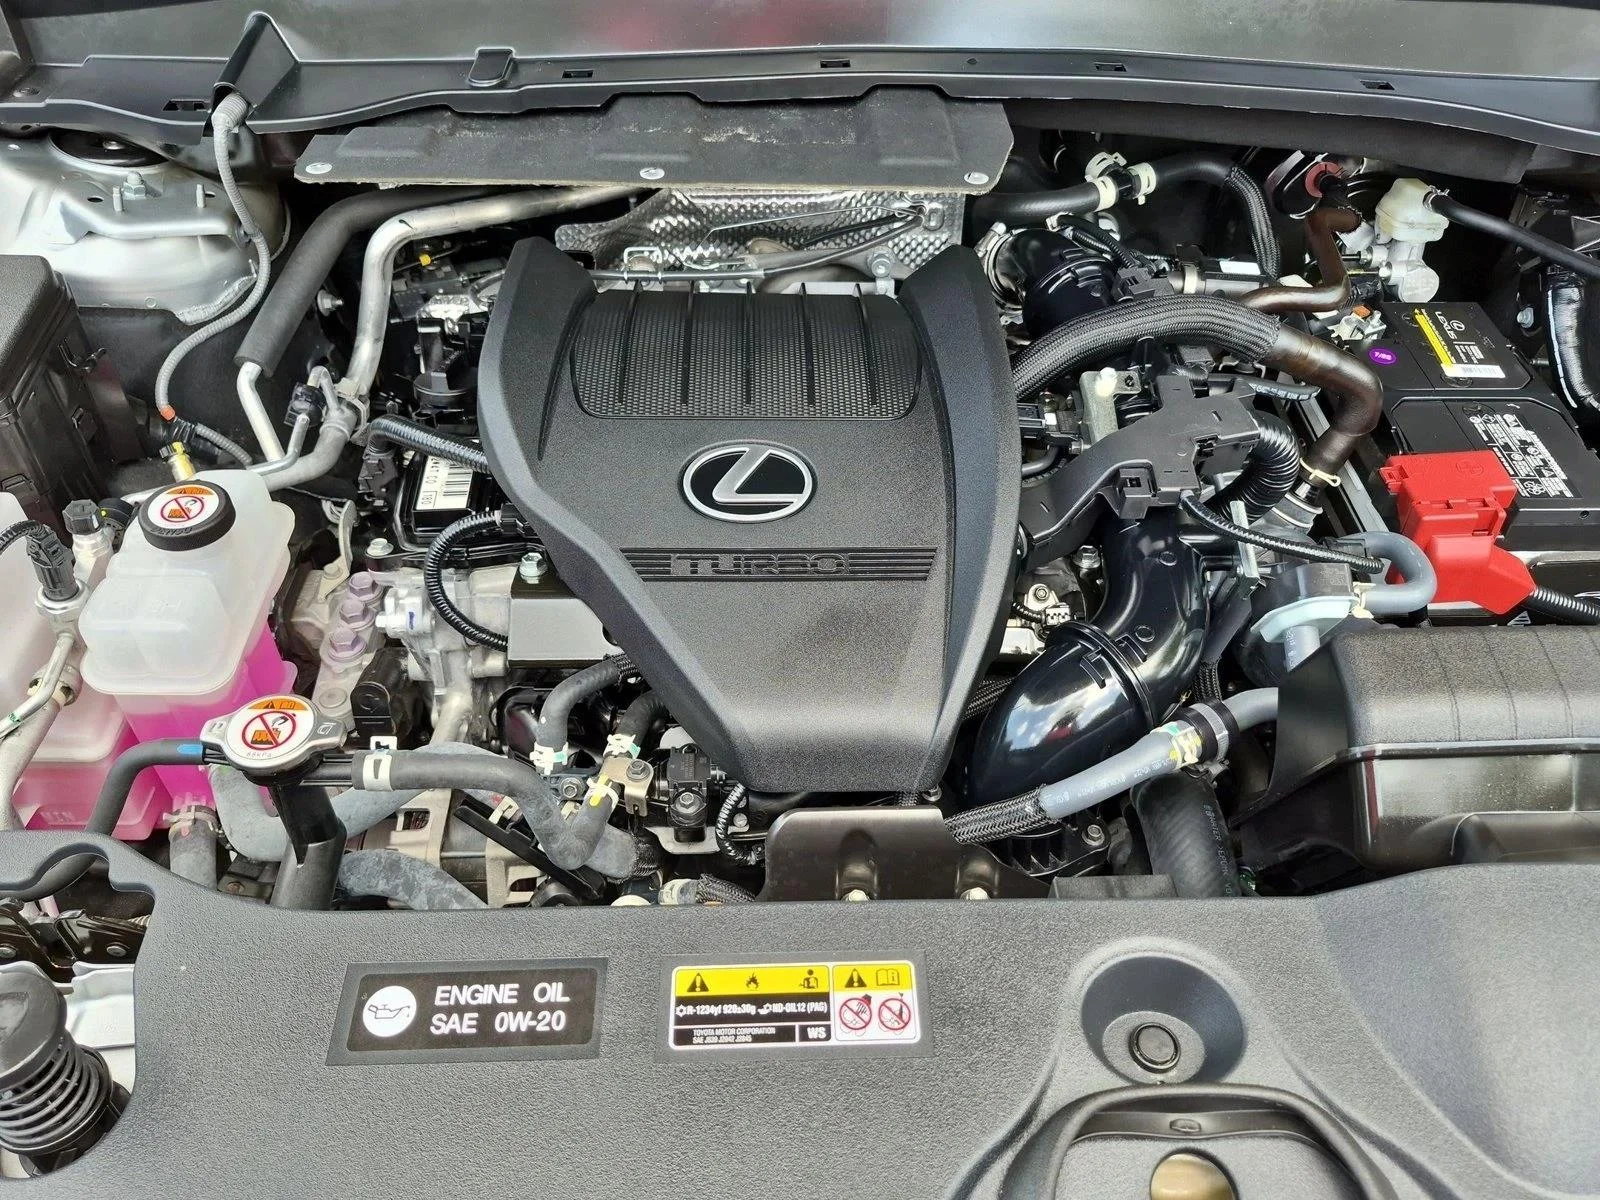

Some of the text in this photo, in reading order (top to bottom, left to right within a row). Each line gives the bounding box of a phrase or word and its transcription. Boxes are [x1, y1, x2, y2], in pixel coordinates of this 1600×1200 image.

[1435, 312, 1458, 340] LEXUS
[675, 553, 846, 575] TURBO
[435, 982, 570, 1006] ENGINE OIL
[430, 1010, 566, 1035] SAE 0W-20
[807, 1026, 827, 1040] WS
